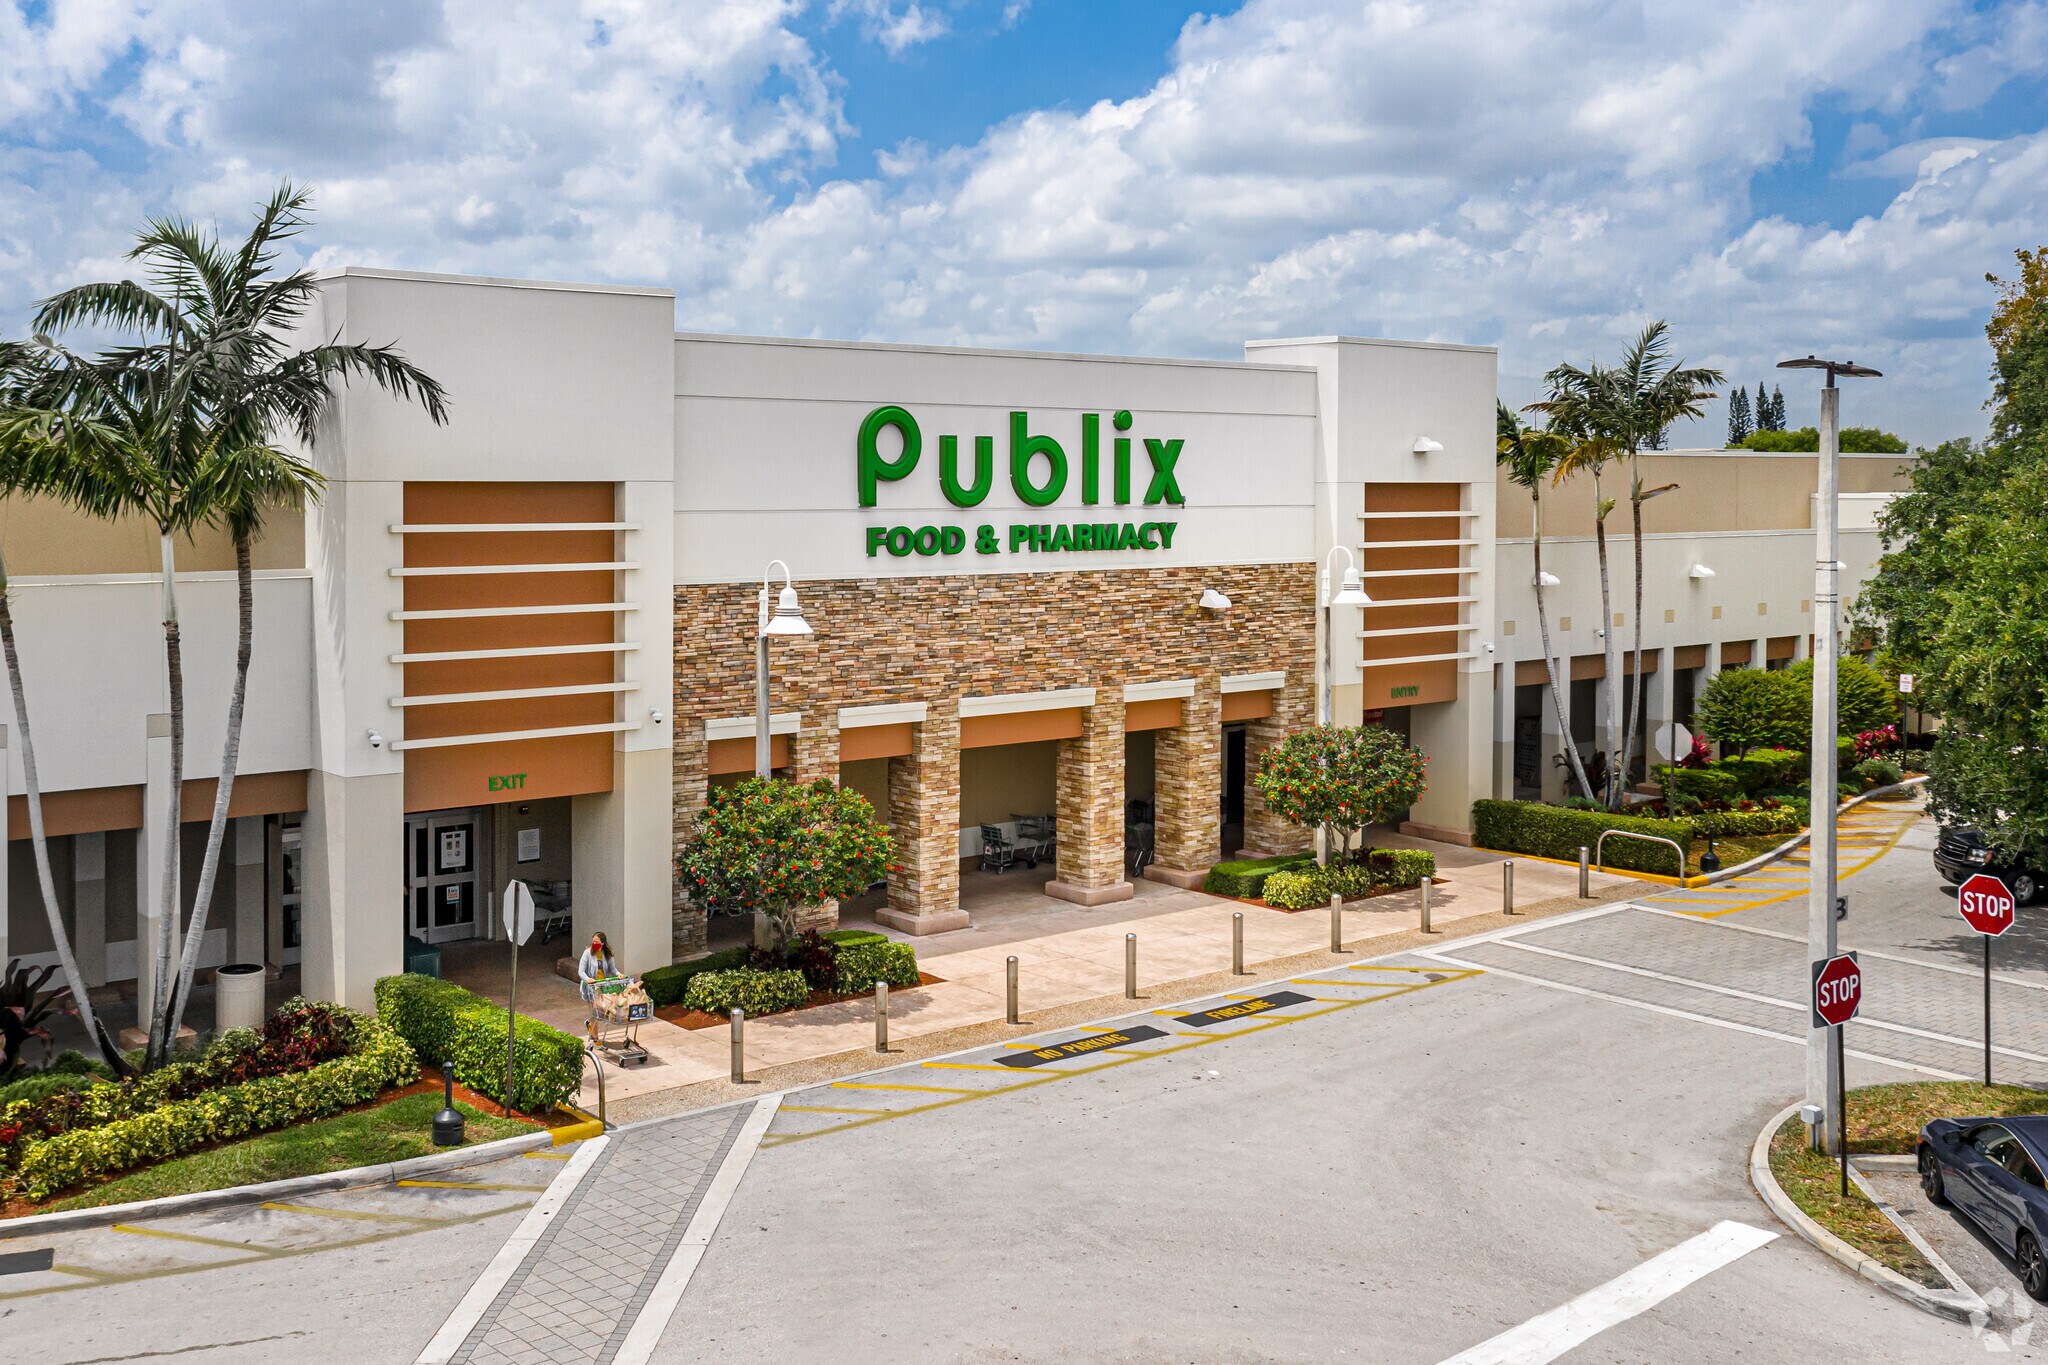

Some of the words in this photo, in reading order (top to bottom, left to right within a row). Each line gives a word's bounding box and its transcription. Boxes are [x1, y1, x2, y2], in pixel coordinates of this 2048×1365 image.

[857, 405, 1185, 507] Publix
[866, 526, 966, 557] FOOD
[975, 524, 1000, 554] &
[1009, 521, 1178, 553] PHARMACY
[1391, 685, 1419, 699] ENTRY
[489, 773, 527, 791] EXIT
[1962, 891, 2010, 919] STOP
[1820, 974, 1859, 1008] STOP
[1033, 1048, 1063, 1060] NO
[1061, 1033, 1130, 1053] PARKING
